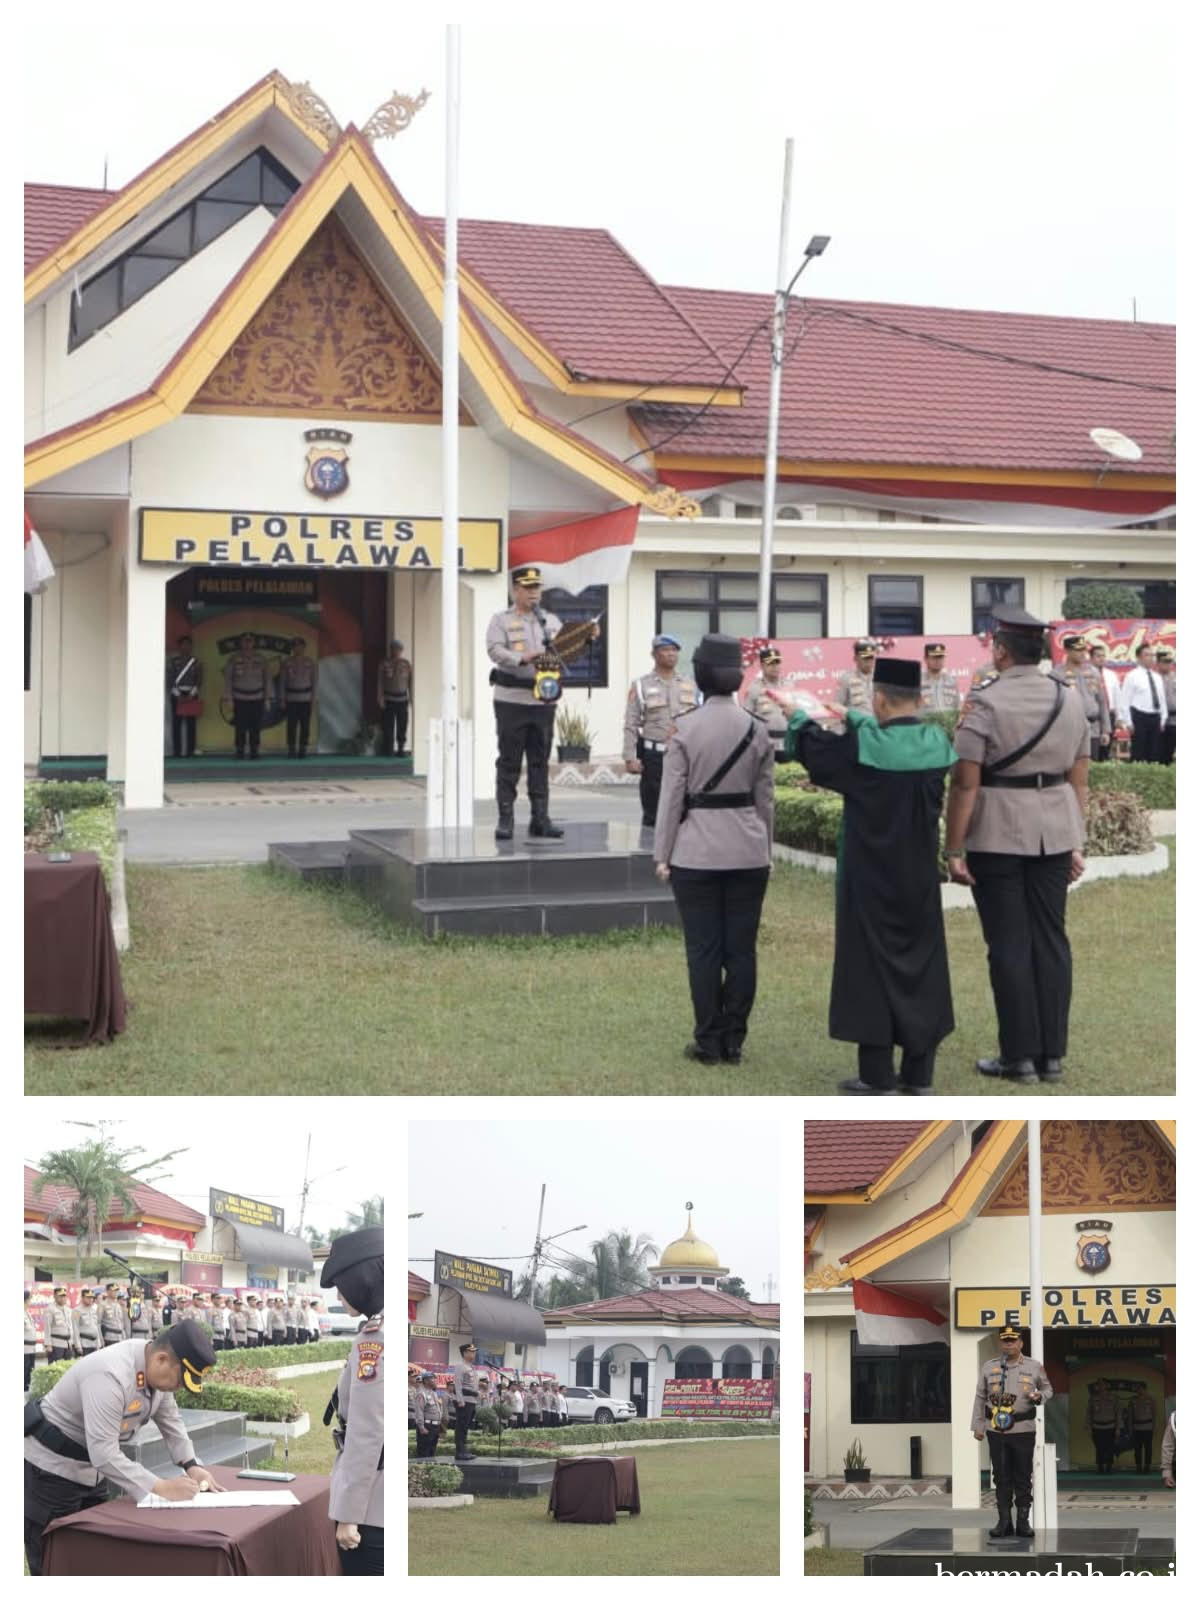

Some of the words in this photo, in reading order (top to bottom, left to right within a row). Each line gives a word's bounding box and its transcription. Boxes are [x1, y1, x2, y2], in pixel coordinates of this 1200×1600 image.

[230, 516, 415, 541] POLRES
[175, 540, 464, 567] PELALAWA
[1020, 1288, 1163, 1307] POLRES
[980, 1308, 1176, 1327] PEALAWA
